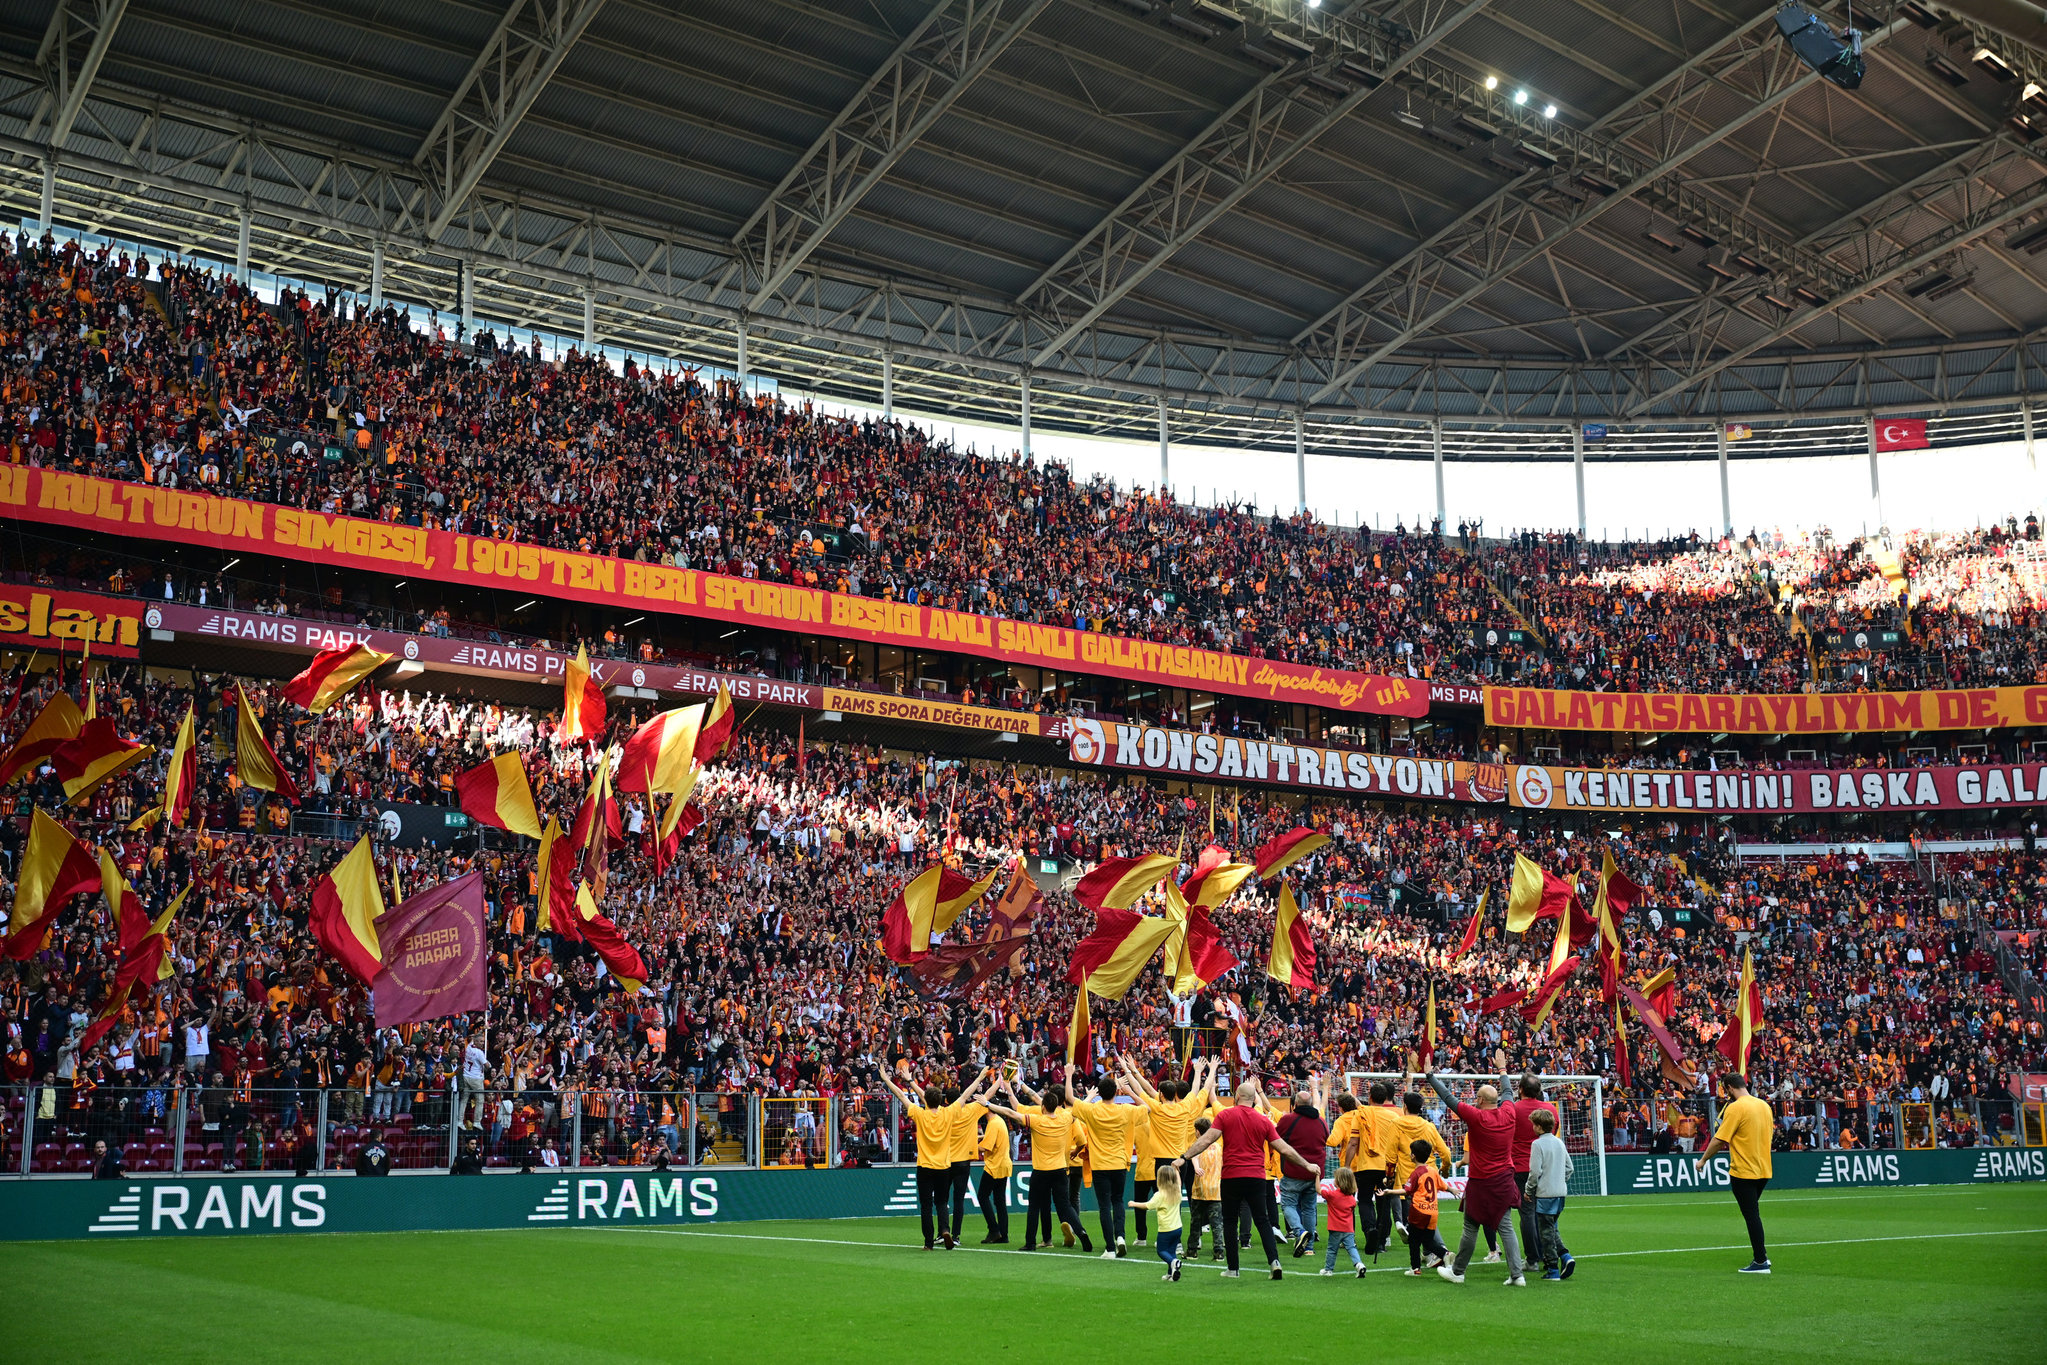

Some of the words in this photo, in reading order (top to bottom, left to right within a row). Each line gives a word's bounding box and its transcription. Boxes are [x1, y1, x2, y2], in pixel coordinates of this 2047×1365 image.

[223, 616, 297, 643] RAMS
[453, 536, 616, 593] 1905'TEN
[623, 562, 697, 605] BERİ
[705, 575, 825, 624] SPORUN
[928, 608, 992, 647] ANLI
[998, 621, 1075, 661] ŞANLI
[1081, 633, 1251, 686] GALATASARAY
[1252, 663, 1371, 707] diyeceksiniz!
[472, 647, 537, 672] RAMS
[757, 683, 809, 705] PARK
[1490, 689, 1925, 732] GALATASARAYLIYIM
[1935, 689, 2009, 728] DE,
[831, 695, 875, 714] RAMS
[879, 703, 929, 721] SPORA
[932, 708, 981, 727] DEĞER
[984, 715, 1030, 733] KATAR
[1115, 724, 1456, 800] KONSANTRASYON!
[1810, 771, 1940, 810] BAŞKA
[1656, 1157, 1731, 1187] RAMS
[1834, 1154, 1900, 1182] RAMS
[1988, 1150, 2045, 1178] RAMS
[578, 1177, 719, 1219] RAMS
[1424, 1176, 1436, 1203] 9
[151, 1184, 326, 1231] RAMS
